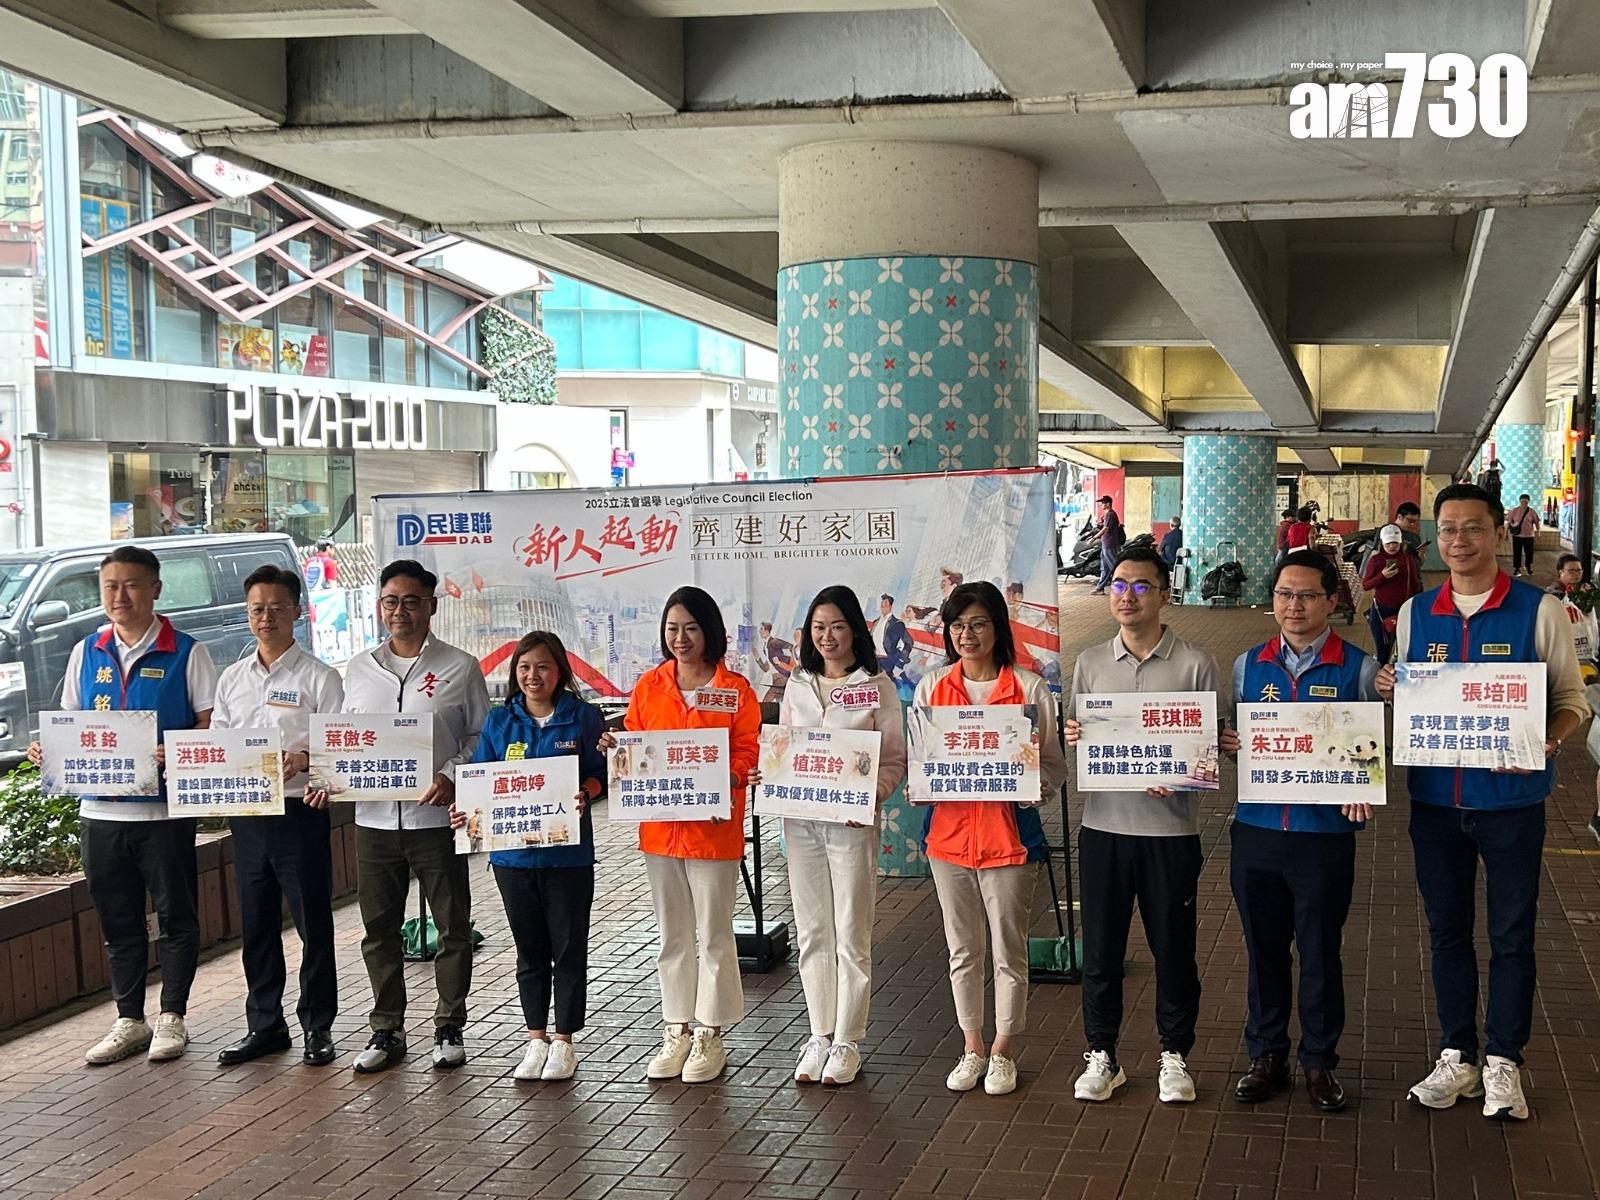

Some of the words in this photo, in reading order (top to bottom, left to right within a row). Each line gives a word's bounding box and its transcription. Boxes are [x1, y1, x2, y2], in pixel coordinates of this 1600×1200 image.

[585, 494, 662, 508] 2025立法會選舉
[665, 494, 720, 507] Legislative
[722, 492, 766, 504] Council
[769, 490, 813, 502] Election
[428, 512, 492, 534] 民建聯
[692, 511, 896, 547] 齊建好家園
[460, 535, 492, 544] DAB
[522, 511, 682, 572] 新人起動
[691, 552, 731, 561] BETTER
[734, 551, 769, 560] HOME,
[774, 549, 829, 559] BRIGHTER
[835, 547, 899, 558] TOMORROW
[94, 666, 112, 712] 姚銘
[417, 672, 450, 697] 冬
[1260, 683, 1281, 702] 朱
[1462, 682, 1527, 702] 張培剛
[697, 692, 737, 707] 郭芙蓉
[843, 691, 879, 705] 植潔鈴
[1141, 709, 1202, 728] 張琪騰
[1410, 715, 1510, 732] 實現置業夢想
[80, 731, 118, 748] 姚銘
[325, 730, 377, 748] 葉傲冬
[944, 731, 1000, 750] 李清霞
[1251, 734, 1314, 754] 朱立威
[1410, 734, 1510, 751] 改善居住環境
[176, 747, 226, 764] 洪錦鉉
[667, 745, 719, 764] 郭芙蓉
[1088, 745, 1172, 758] 發展綠色航運
[64, 758, 135, 770] 加快北都發展
[336, 759, 417, 772] 完善交通配套
[792, 754, 844, 774] 植潔鈴
[923, 762, 1024, 777] 爭取收費合理的
[1088, 761, 1188, 775] 推動建立企業通
[64, 772, 135, 784] 拉動香港經濟
[177, 776, 271, 790] 建設國際創科中心
[350, 775, 417, 789] 增加泊車位
[493, 774, 545, 795] 盧婉婷
[621, 778, 694, 791] 關注學童成長
[930, 778, 1017, 792] 優質醫療服務
[1251, 770, 1370, 784] 開發多元旅遊產品
[178, 791, 272, 805] 推進數字經濟建設
[621, 793, 720, 807] 保障本地學生資源
[763, 785, 869, 806] 爭取優質退休生活
[492, 804, 566, 819] 保障本地工人
[492, 821, 541, 835] 優先就業
